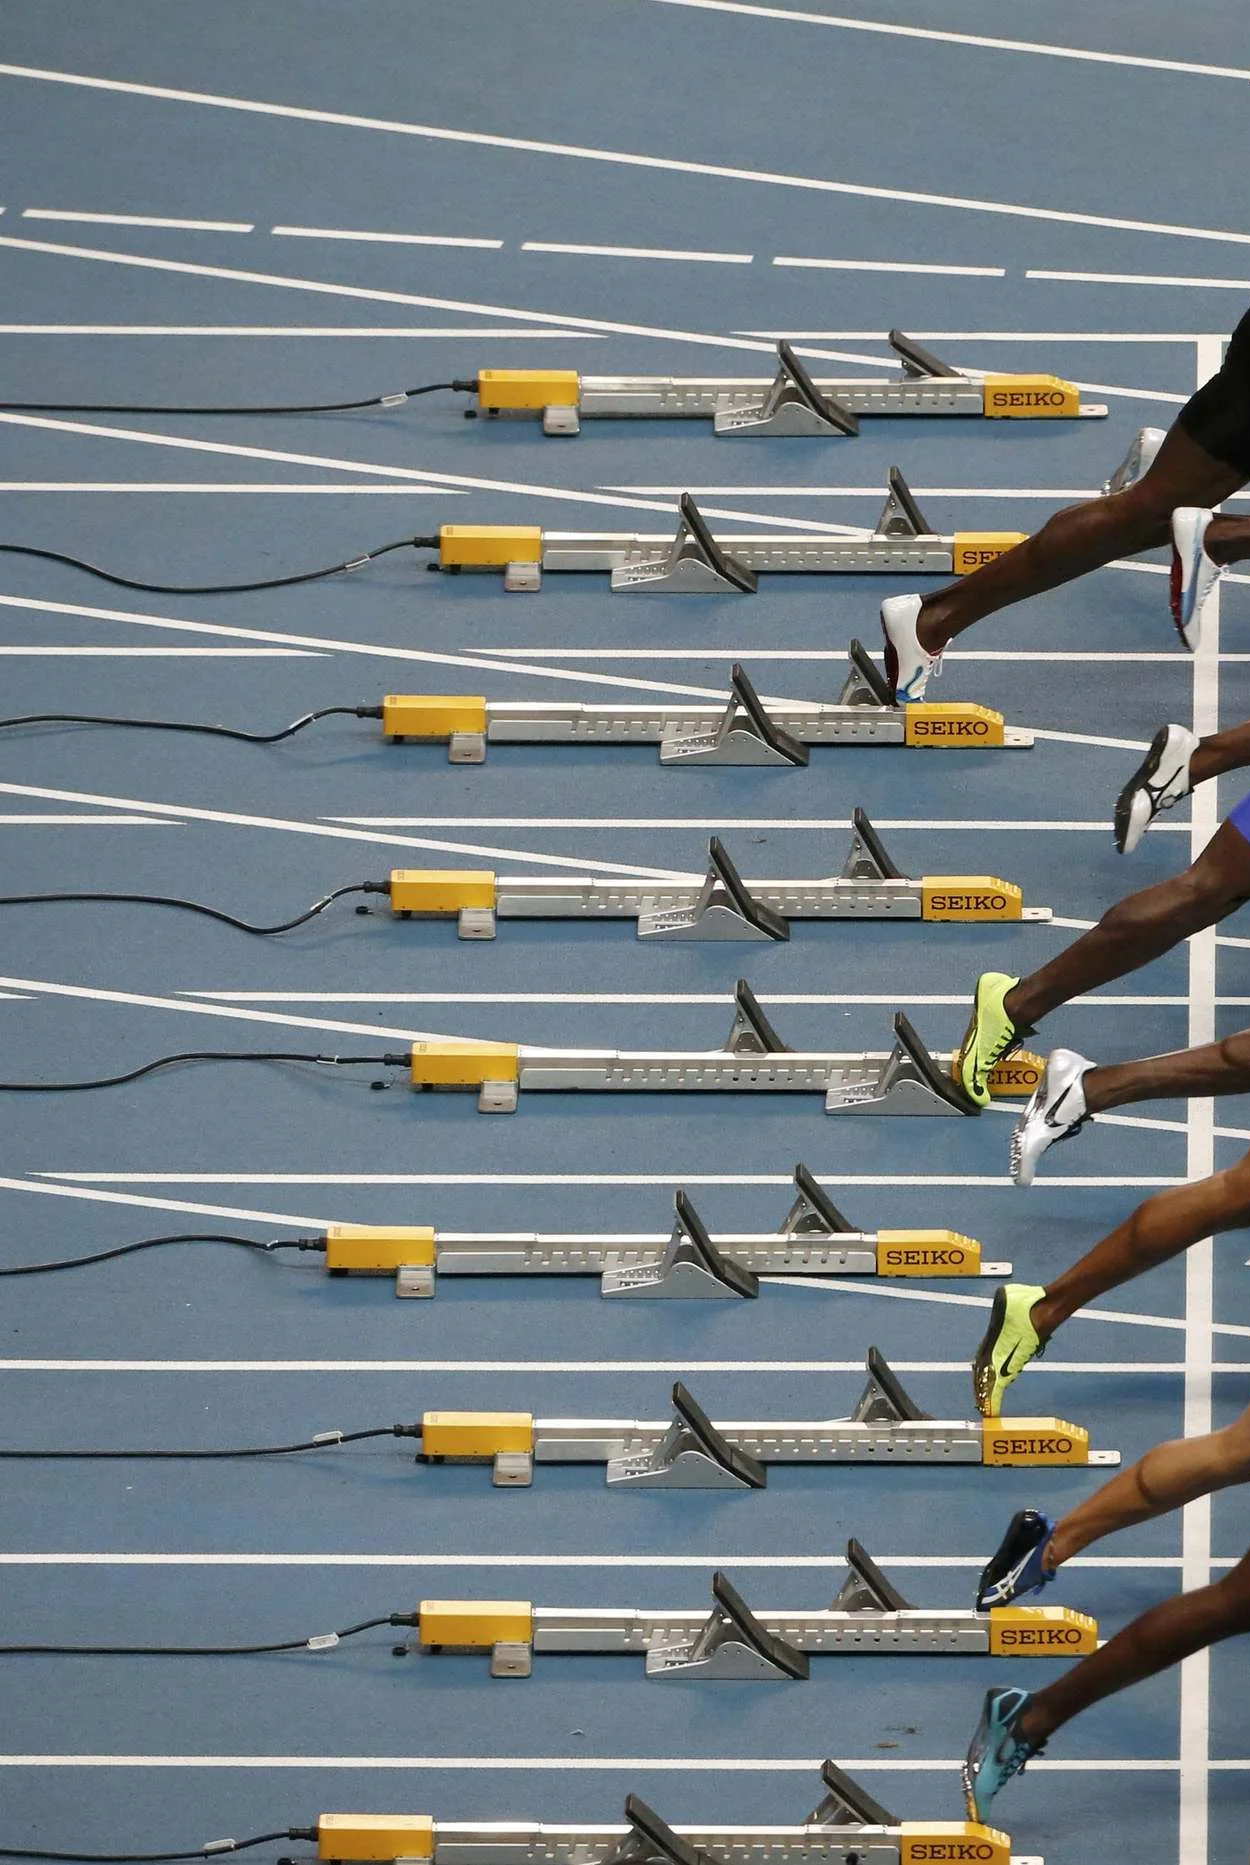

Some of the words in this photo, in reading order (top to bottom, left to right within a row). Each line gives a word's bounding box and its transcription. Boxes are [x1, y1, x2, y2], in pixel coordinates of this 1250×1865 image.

[992, 391, 1065, 407] SEIKO
[914, 720, 989, 736] SEIKO
[930, 895, 1007, 911] SEIKO
[886, 1249, 965, 1265] SEIKO
[992, 1438, 1073, 1455] SEIKO
[1000, 1628, 1083, 1646] SEIKO
[911, 1844, 994, 1861] SEIKO
